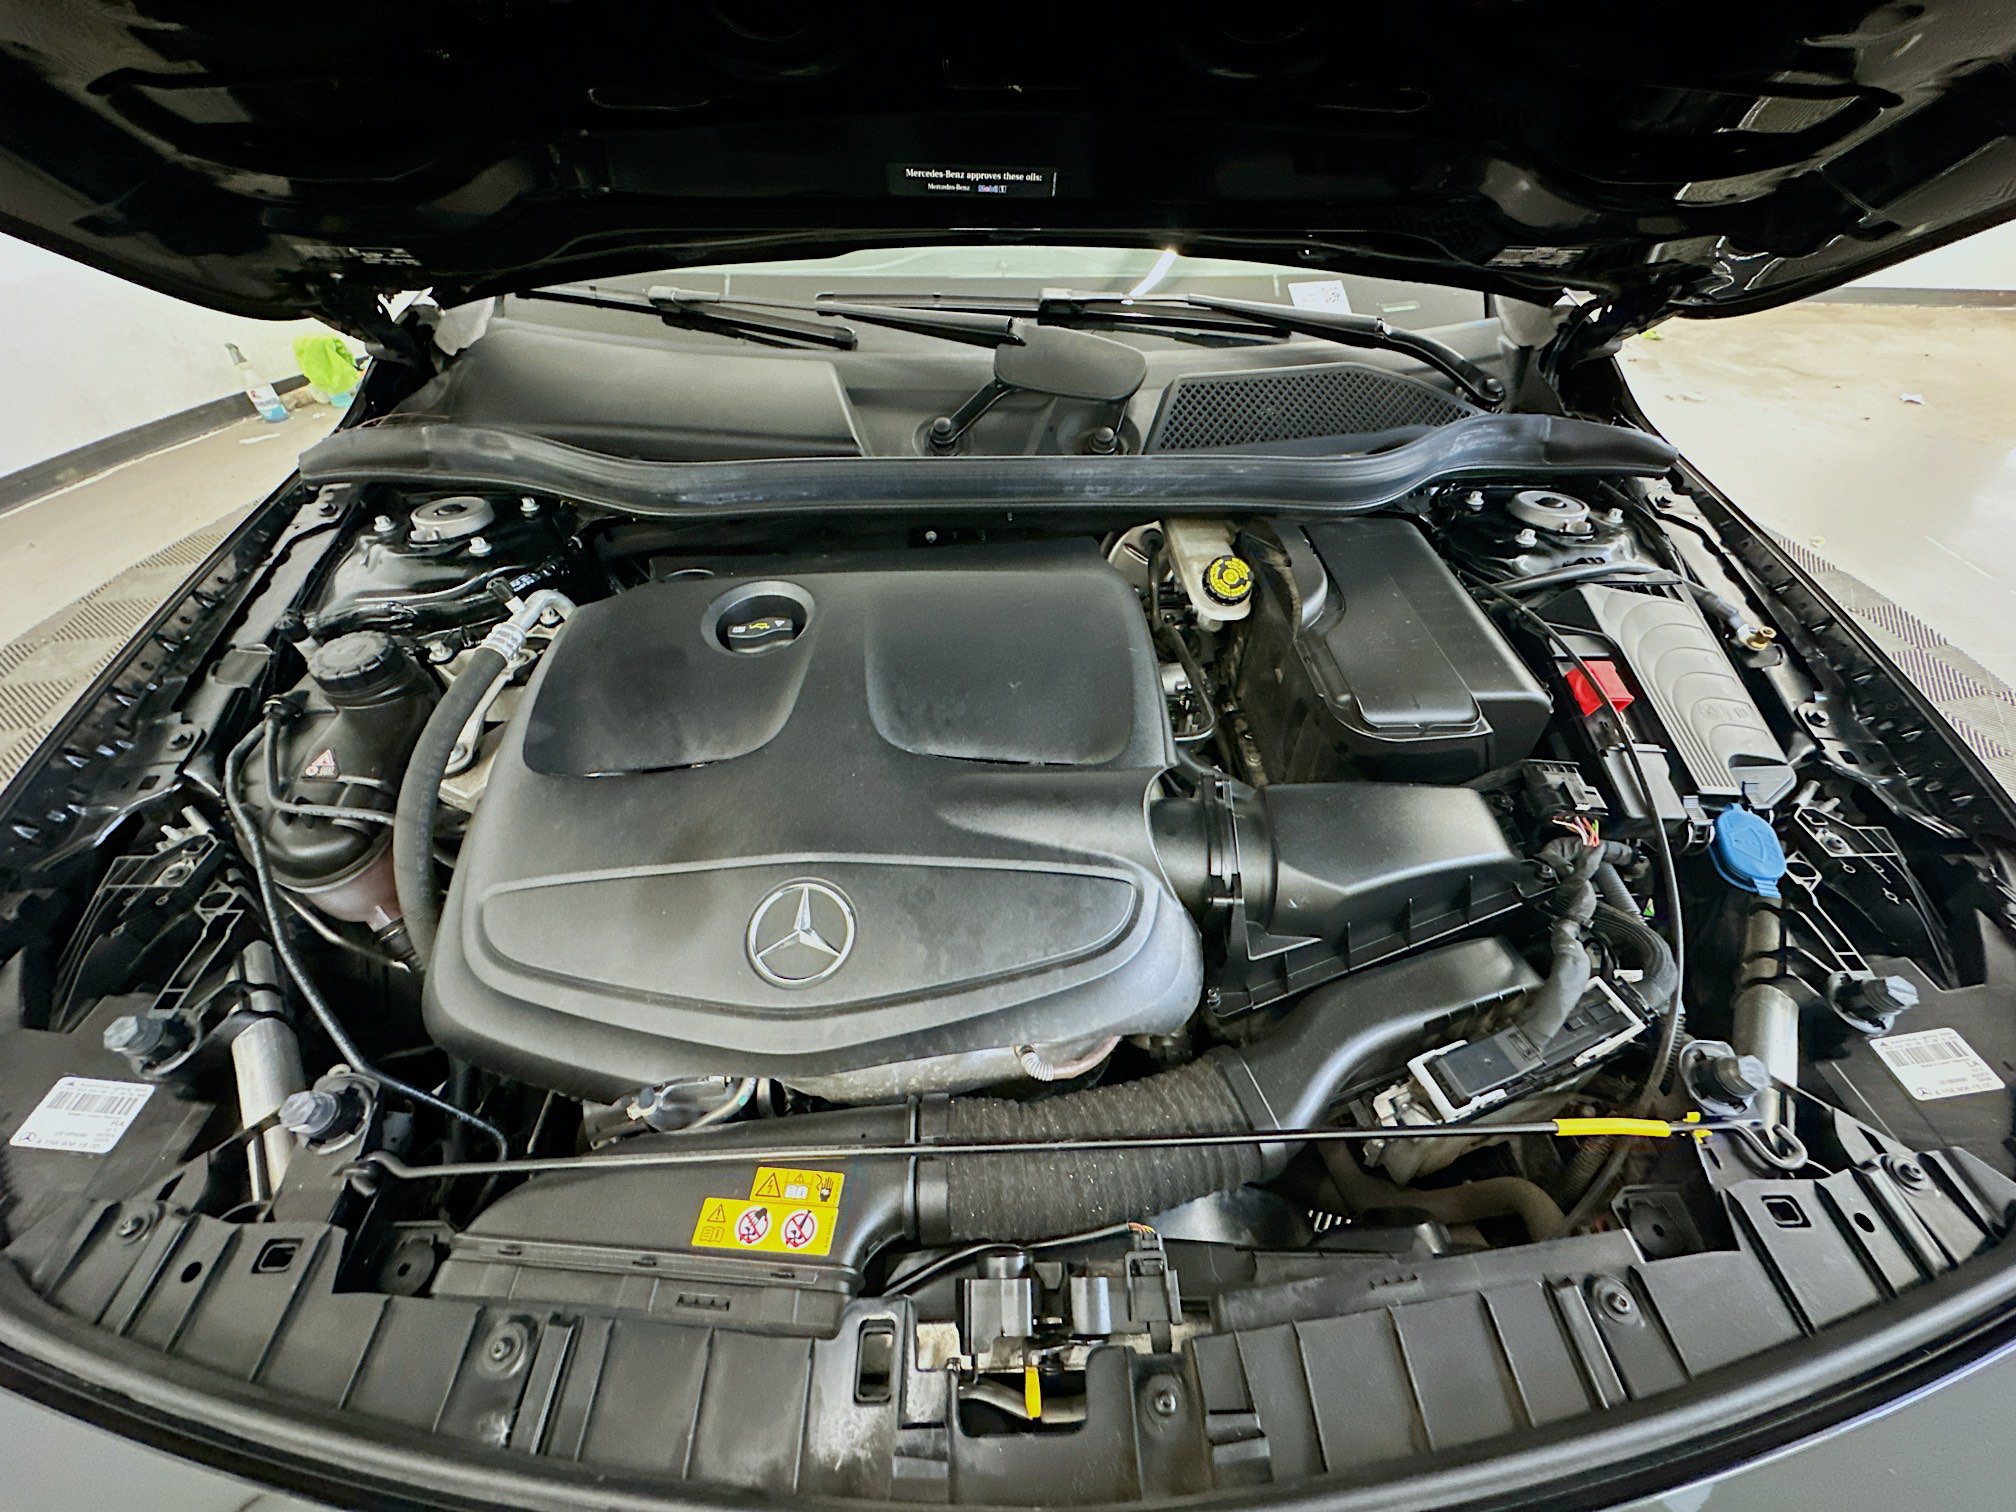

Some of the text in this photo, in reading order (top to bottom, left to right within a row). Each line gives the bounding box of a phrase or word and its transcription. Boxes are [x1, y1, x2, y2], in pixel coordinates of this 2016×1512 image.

[905, 168, 1043, 182] Mercedes-Benz approves these oils:
[927, 183, 970, 192] Mercedes-Benz
